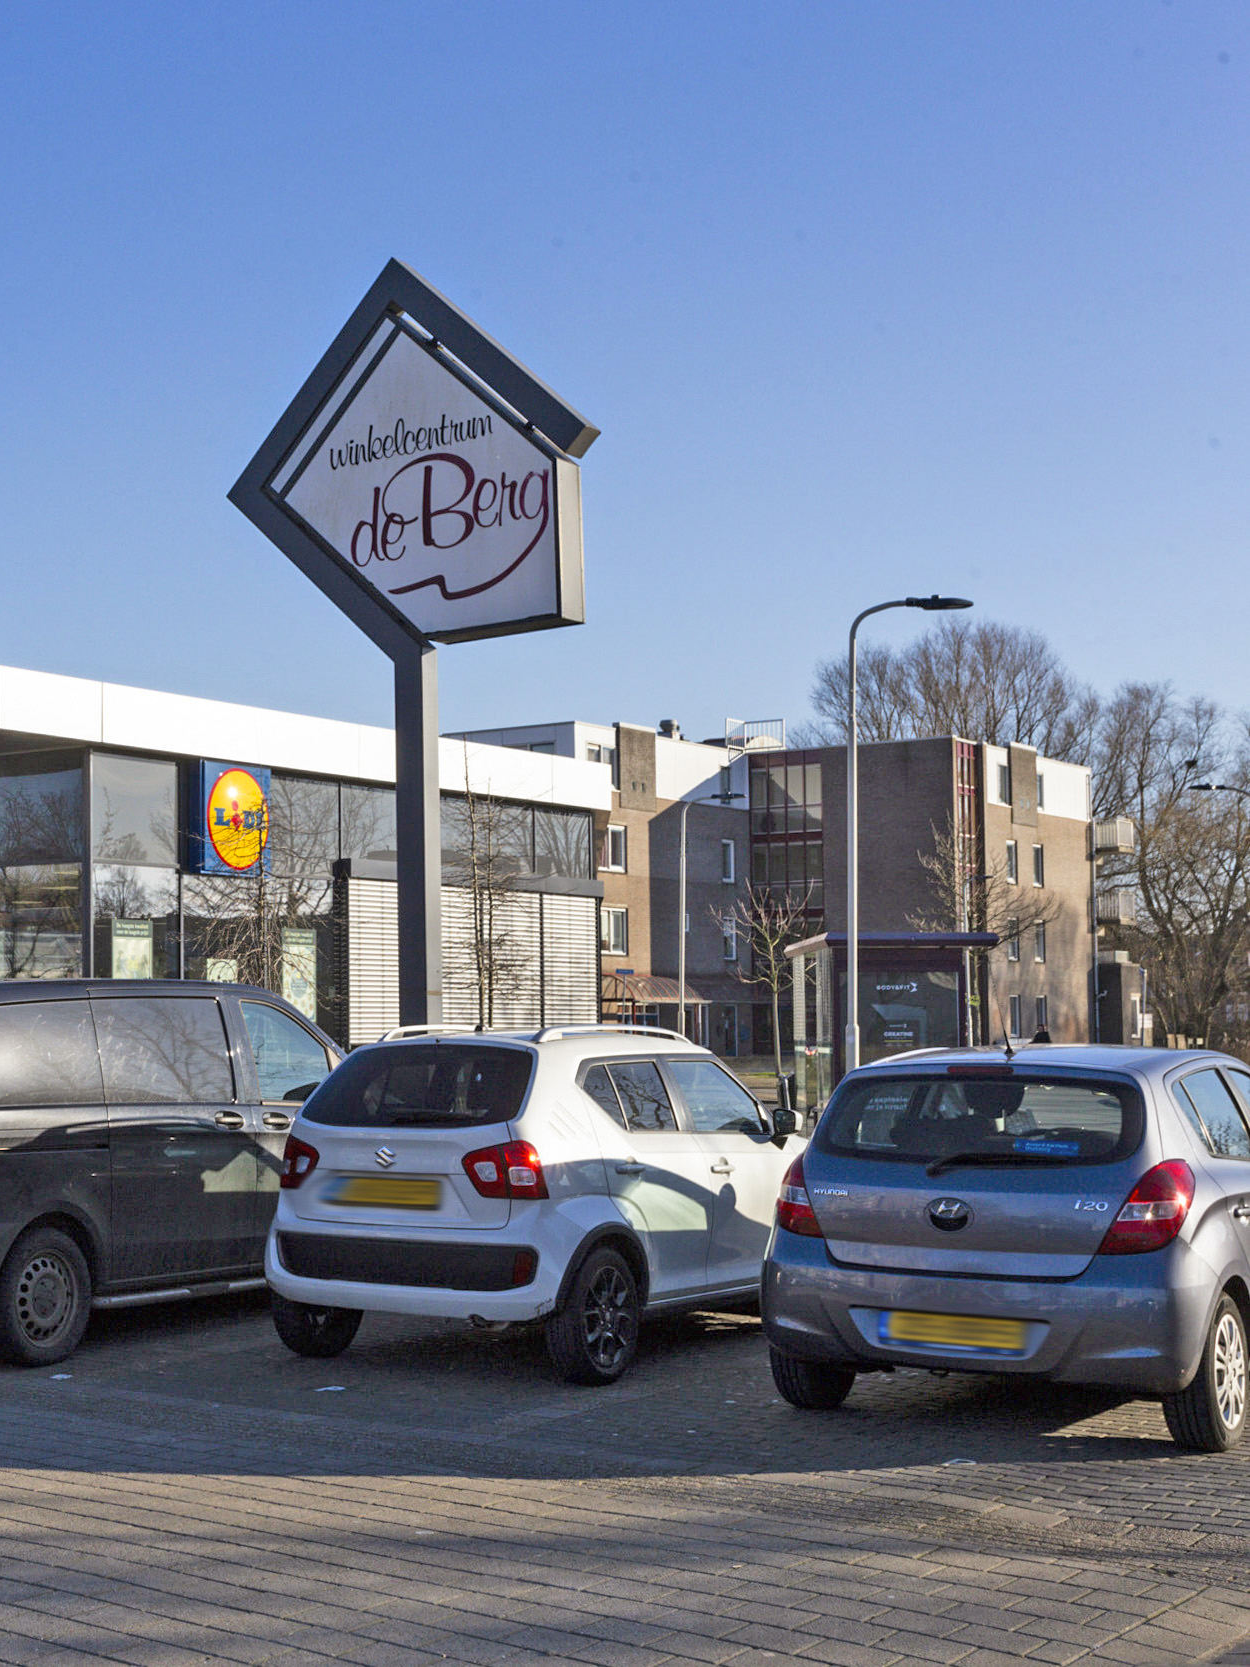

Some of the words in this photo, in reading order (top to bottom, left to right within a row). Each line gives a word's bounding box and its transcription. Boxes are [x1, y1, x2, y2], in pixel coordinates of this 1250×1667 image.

[330, 414, 493, 470] winkelcentrum
[351, 486, 418, 567] de
[382, 453, 549, 600] Berg
[814, 1187, 849, 1197] HYUNDAI
[1074, 1199, 1109, 1212] i20
